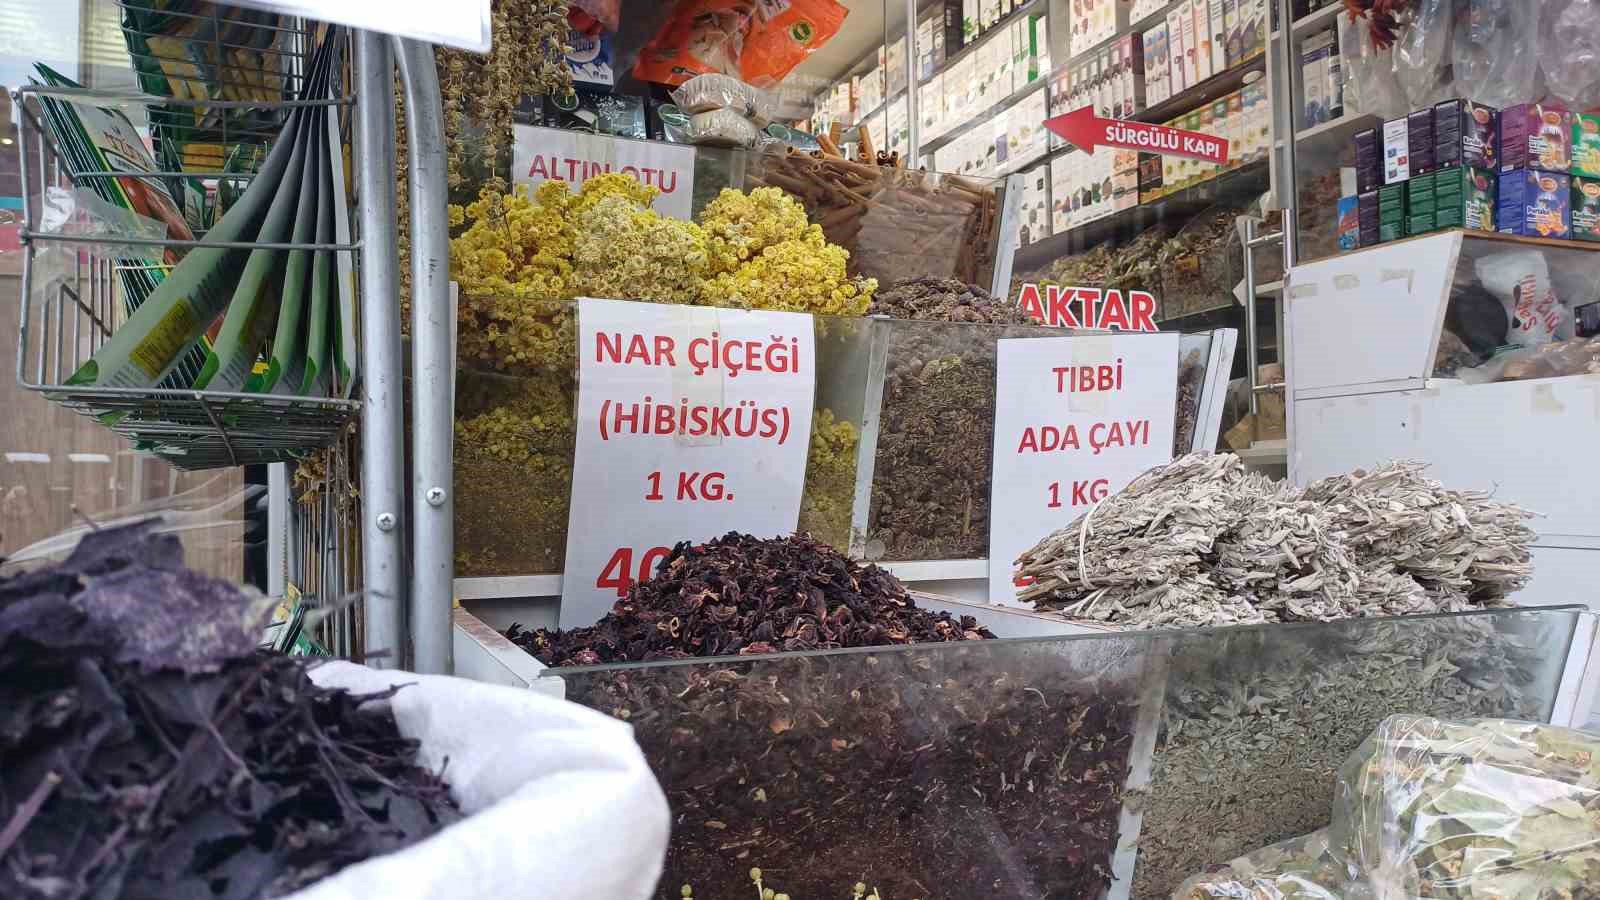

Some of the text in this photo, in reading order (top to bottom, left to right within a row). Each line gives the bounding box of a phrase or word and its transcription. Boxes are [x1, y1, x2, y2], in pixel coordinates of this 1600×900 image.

[1105, 122, 1220, 158] SÜRGÜLÜ KAPI
[528, 154, 611, 183] ALTIN
[1016, 283, 1159, 332] AKTAR
[595, 331, 799, 378] NAR ÇİÇEĞİ
[1052, 357, 1123, 393] TIBBİ
[599, 396, 791, 445] (HİBİSKÜS)
[1017, 420, 1150, 455] ADA ÇAYI
[645, 471, 735, 502] 1 KG.
[1047, 482, 1062, 508] 1
